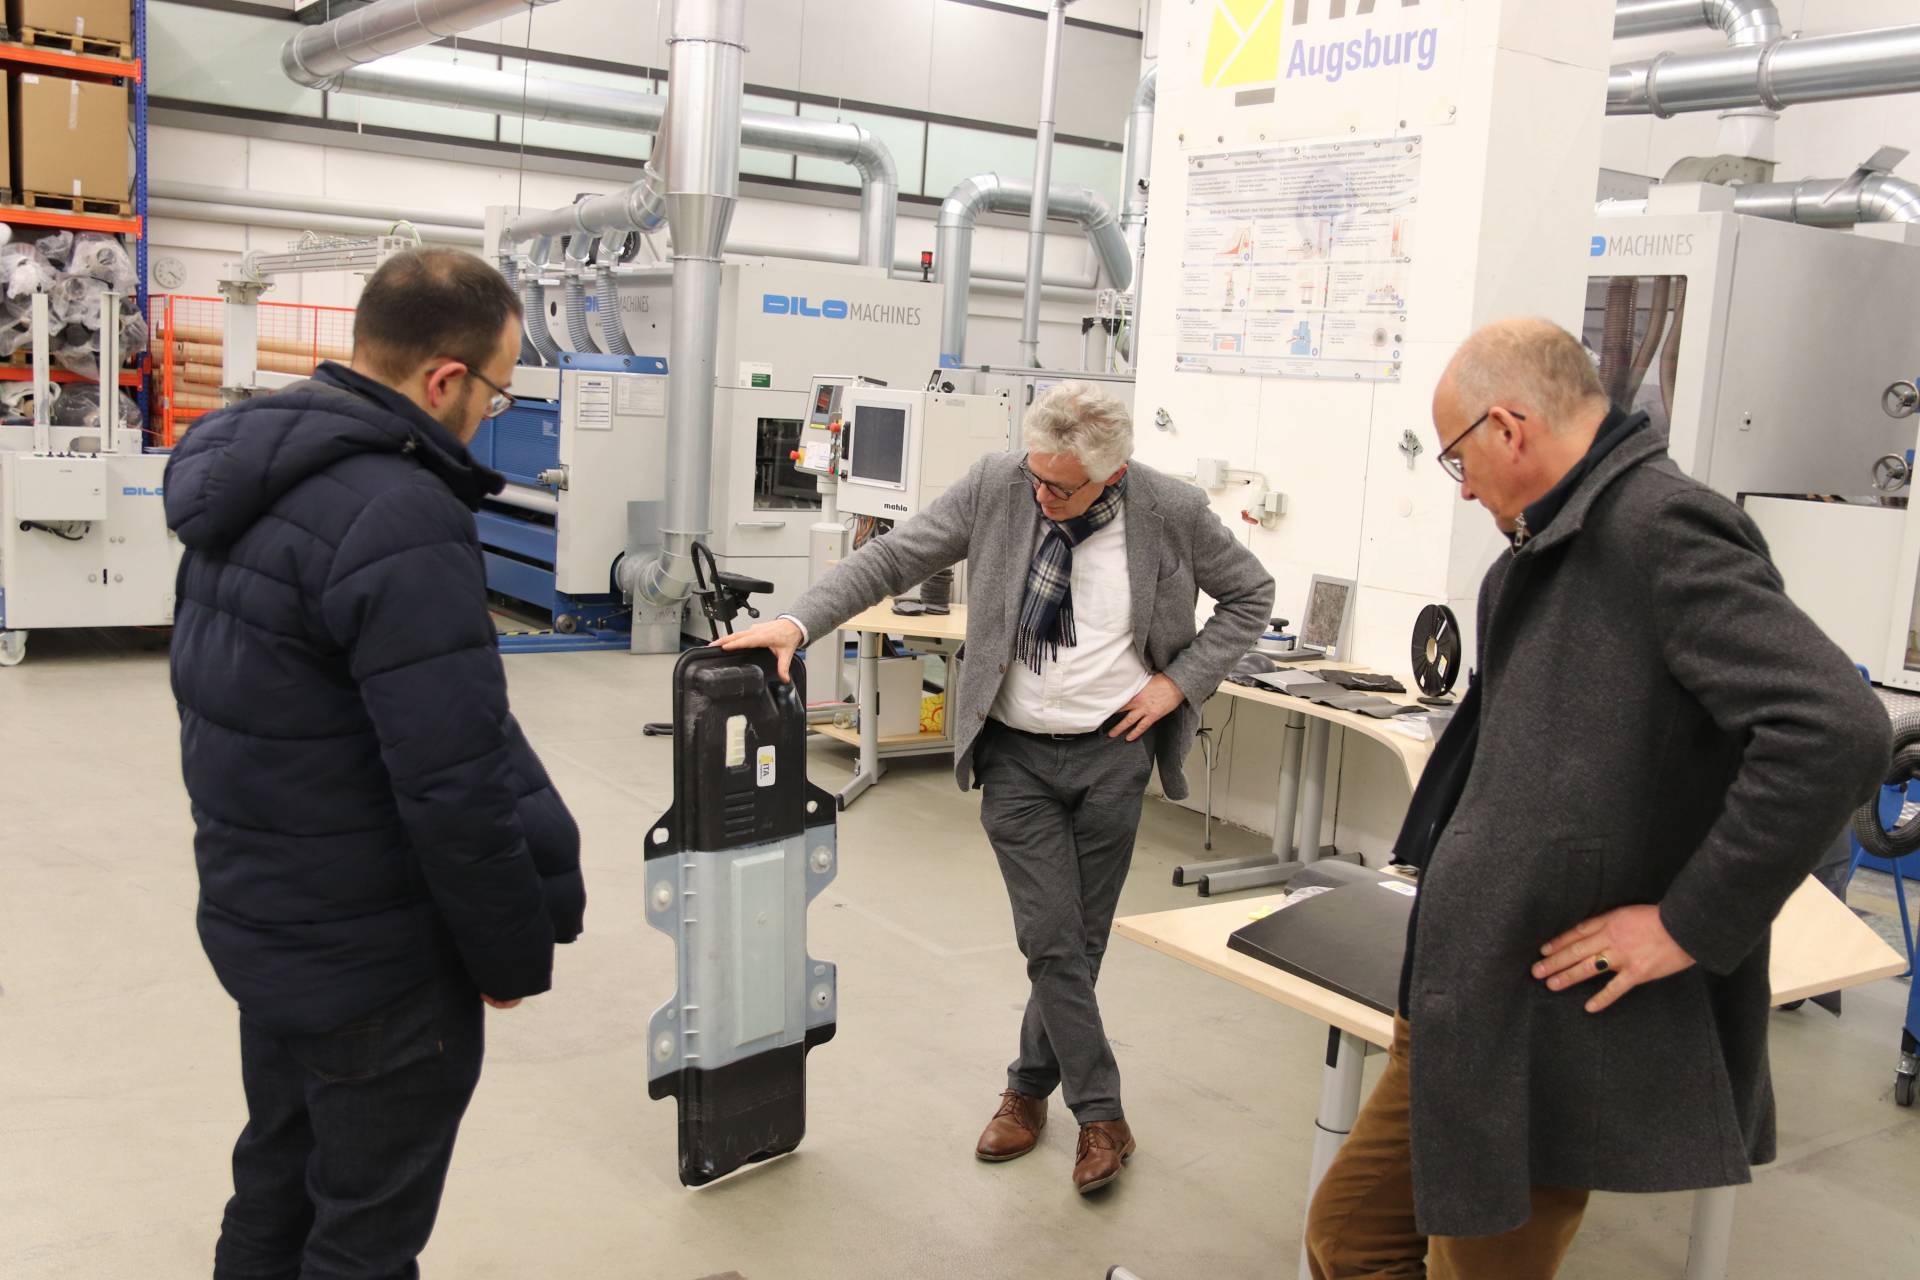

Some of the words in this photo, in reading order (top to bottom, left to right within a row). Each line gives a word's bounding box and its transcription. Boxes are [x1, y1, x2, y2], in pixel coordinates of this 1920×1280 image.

[1286, 28, 1437, 82] Augsburg
[1609, 234, 1694, 256] MACHINES
[763, 294, 848, 319] DILO
[850, 301, 921, 326] MACHINES
